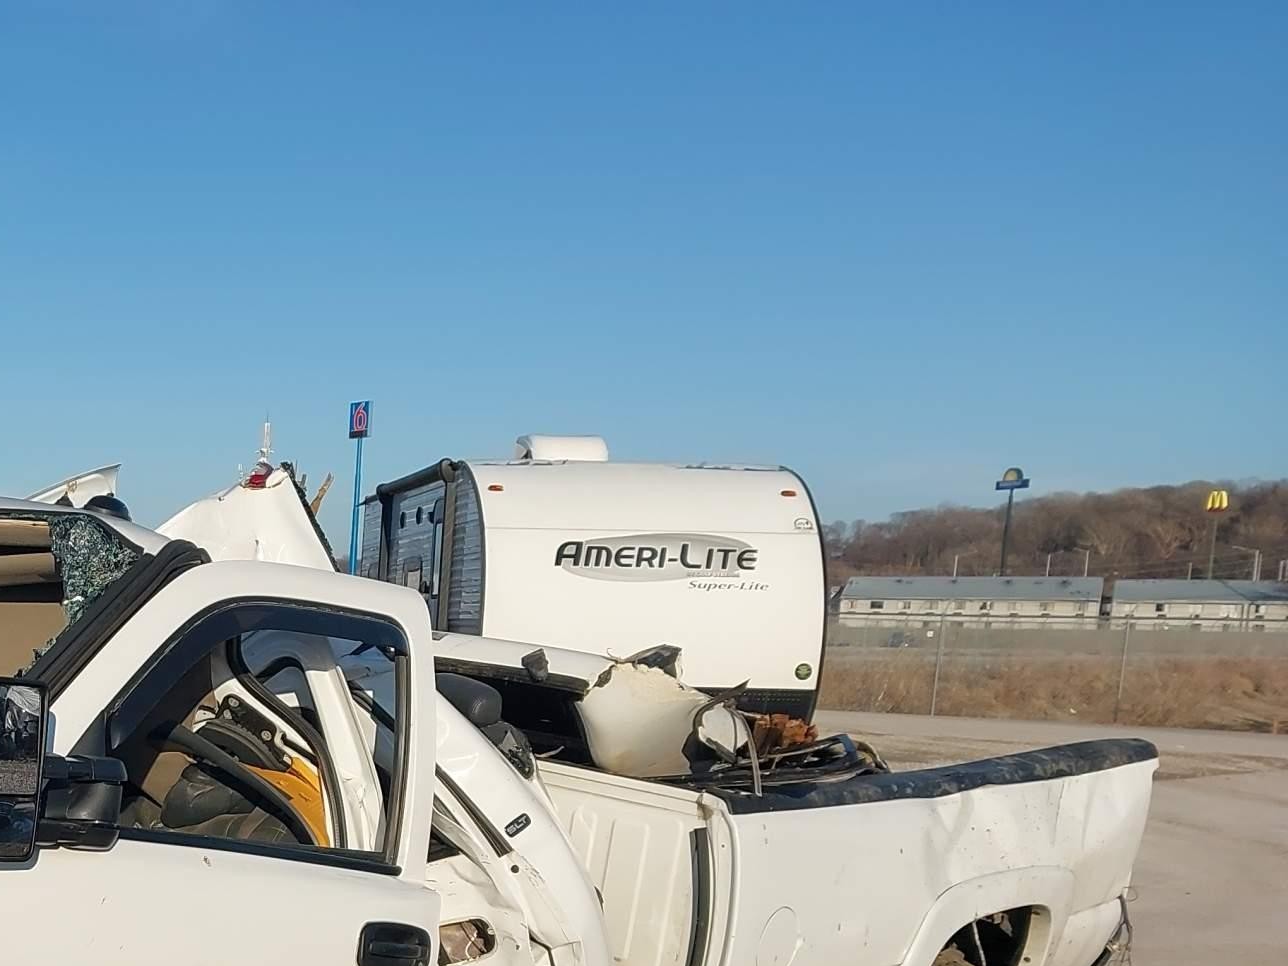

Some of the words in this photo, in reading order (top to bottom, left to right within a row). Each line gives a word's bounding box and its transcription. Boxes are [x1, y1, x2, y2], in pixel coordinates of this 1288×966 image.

[354, 402, 367, 431] 6
[688, 580, 769, 592] Super-Lite
[506, 815, 527, 835] SLT
